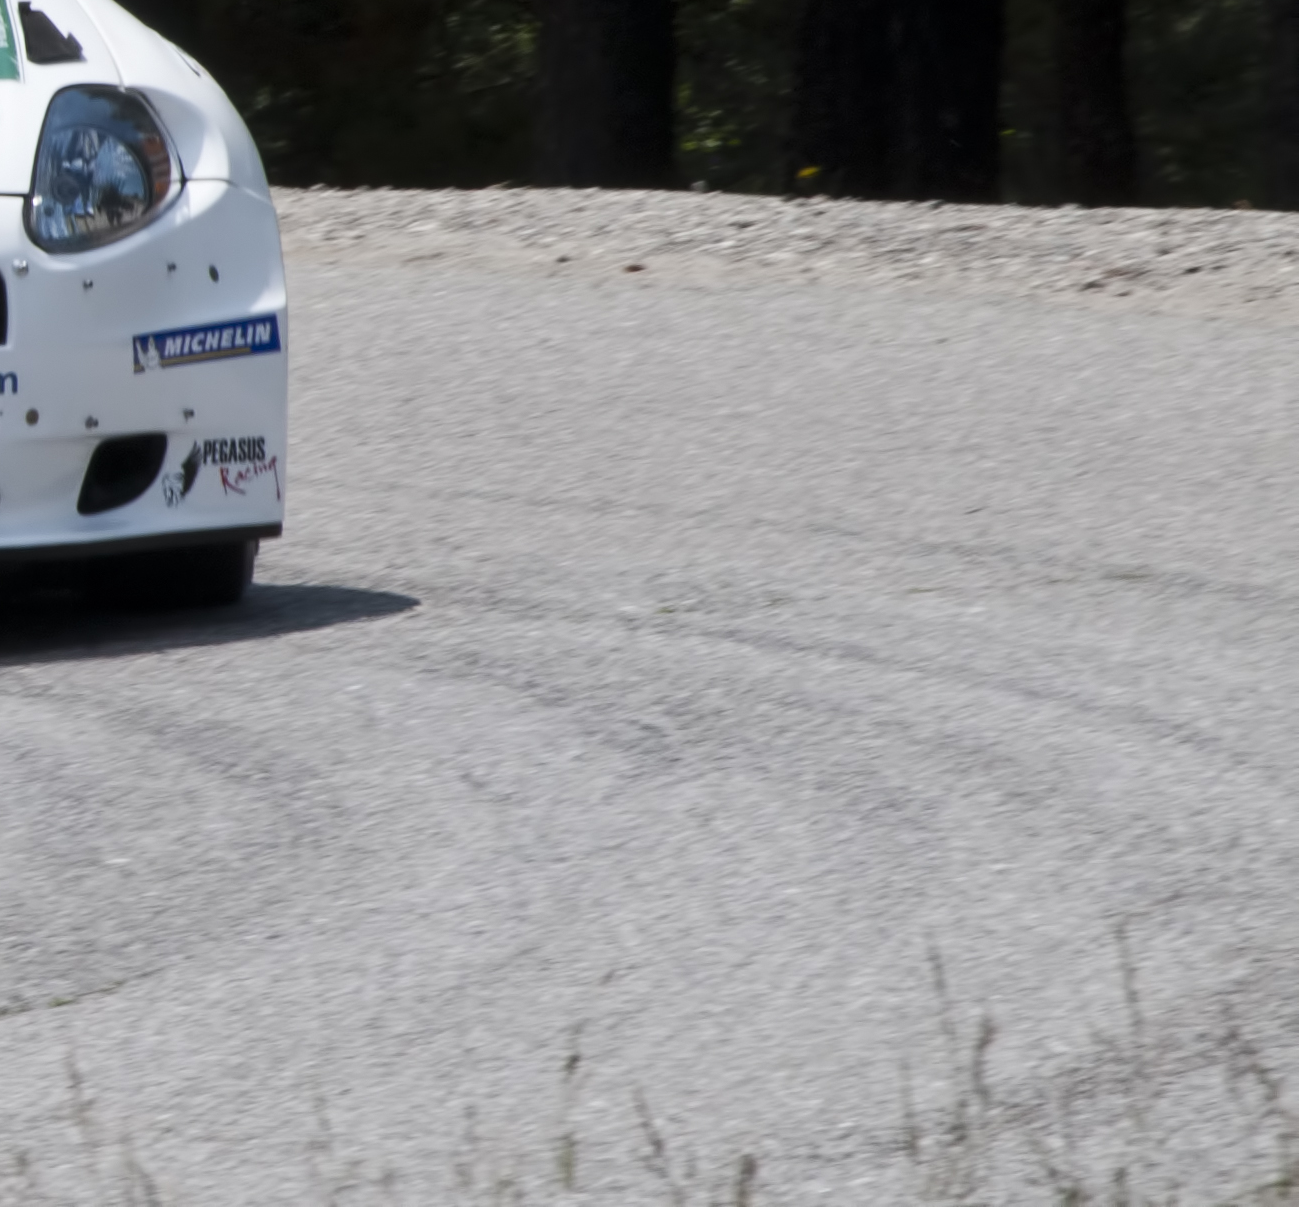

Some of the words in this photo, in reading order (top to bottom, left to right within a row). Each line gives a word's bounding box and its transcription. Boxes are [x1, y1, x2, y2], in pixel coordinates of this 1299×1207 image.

[164, 321, 271, 358] MICHELIN
[202, 435, 266, 466] PEGASUS
[219, 455, 280, 503] Racing
